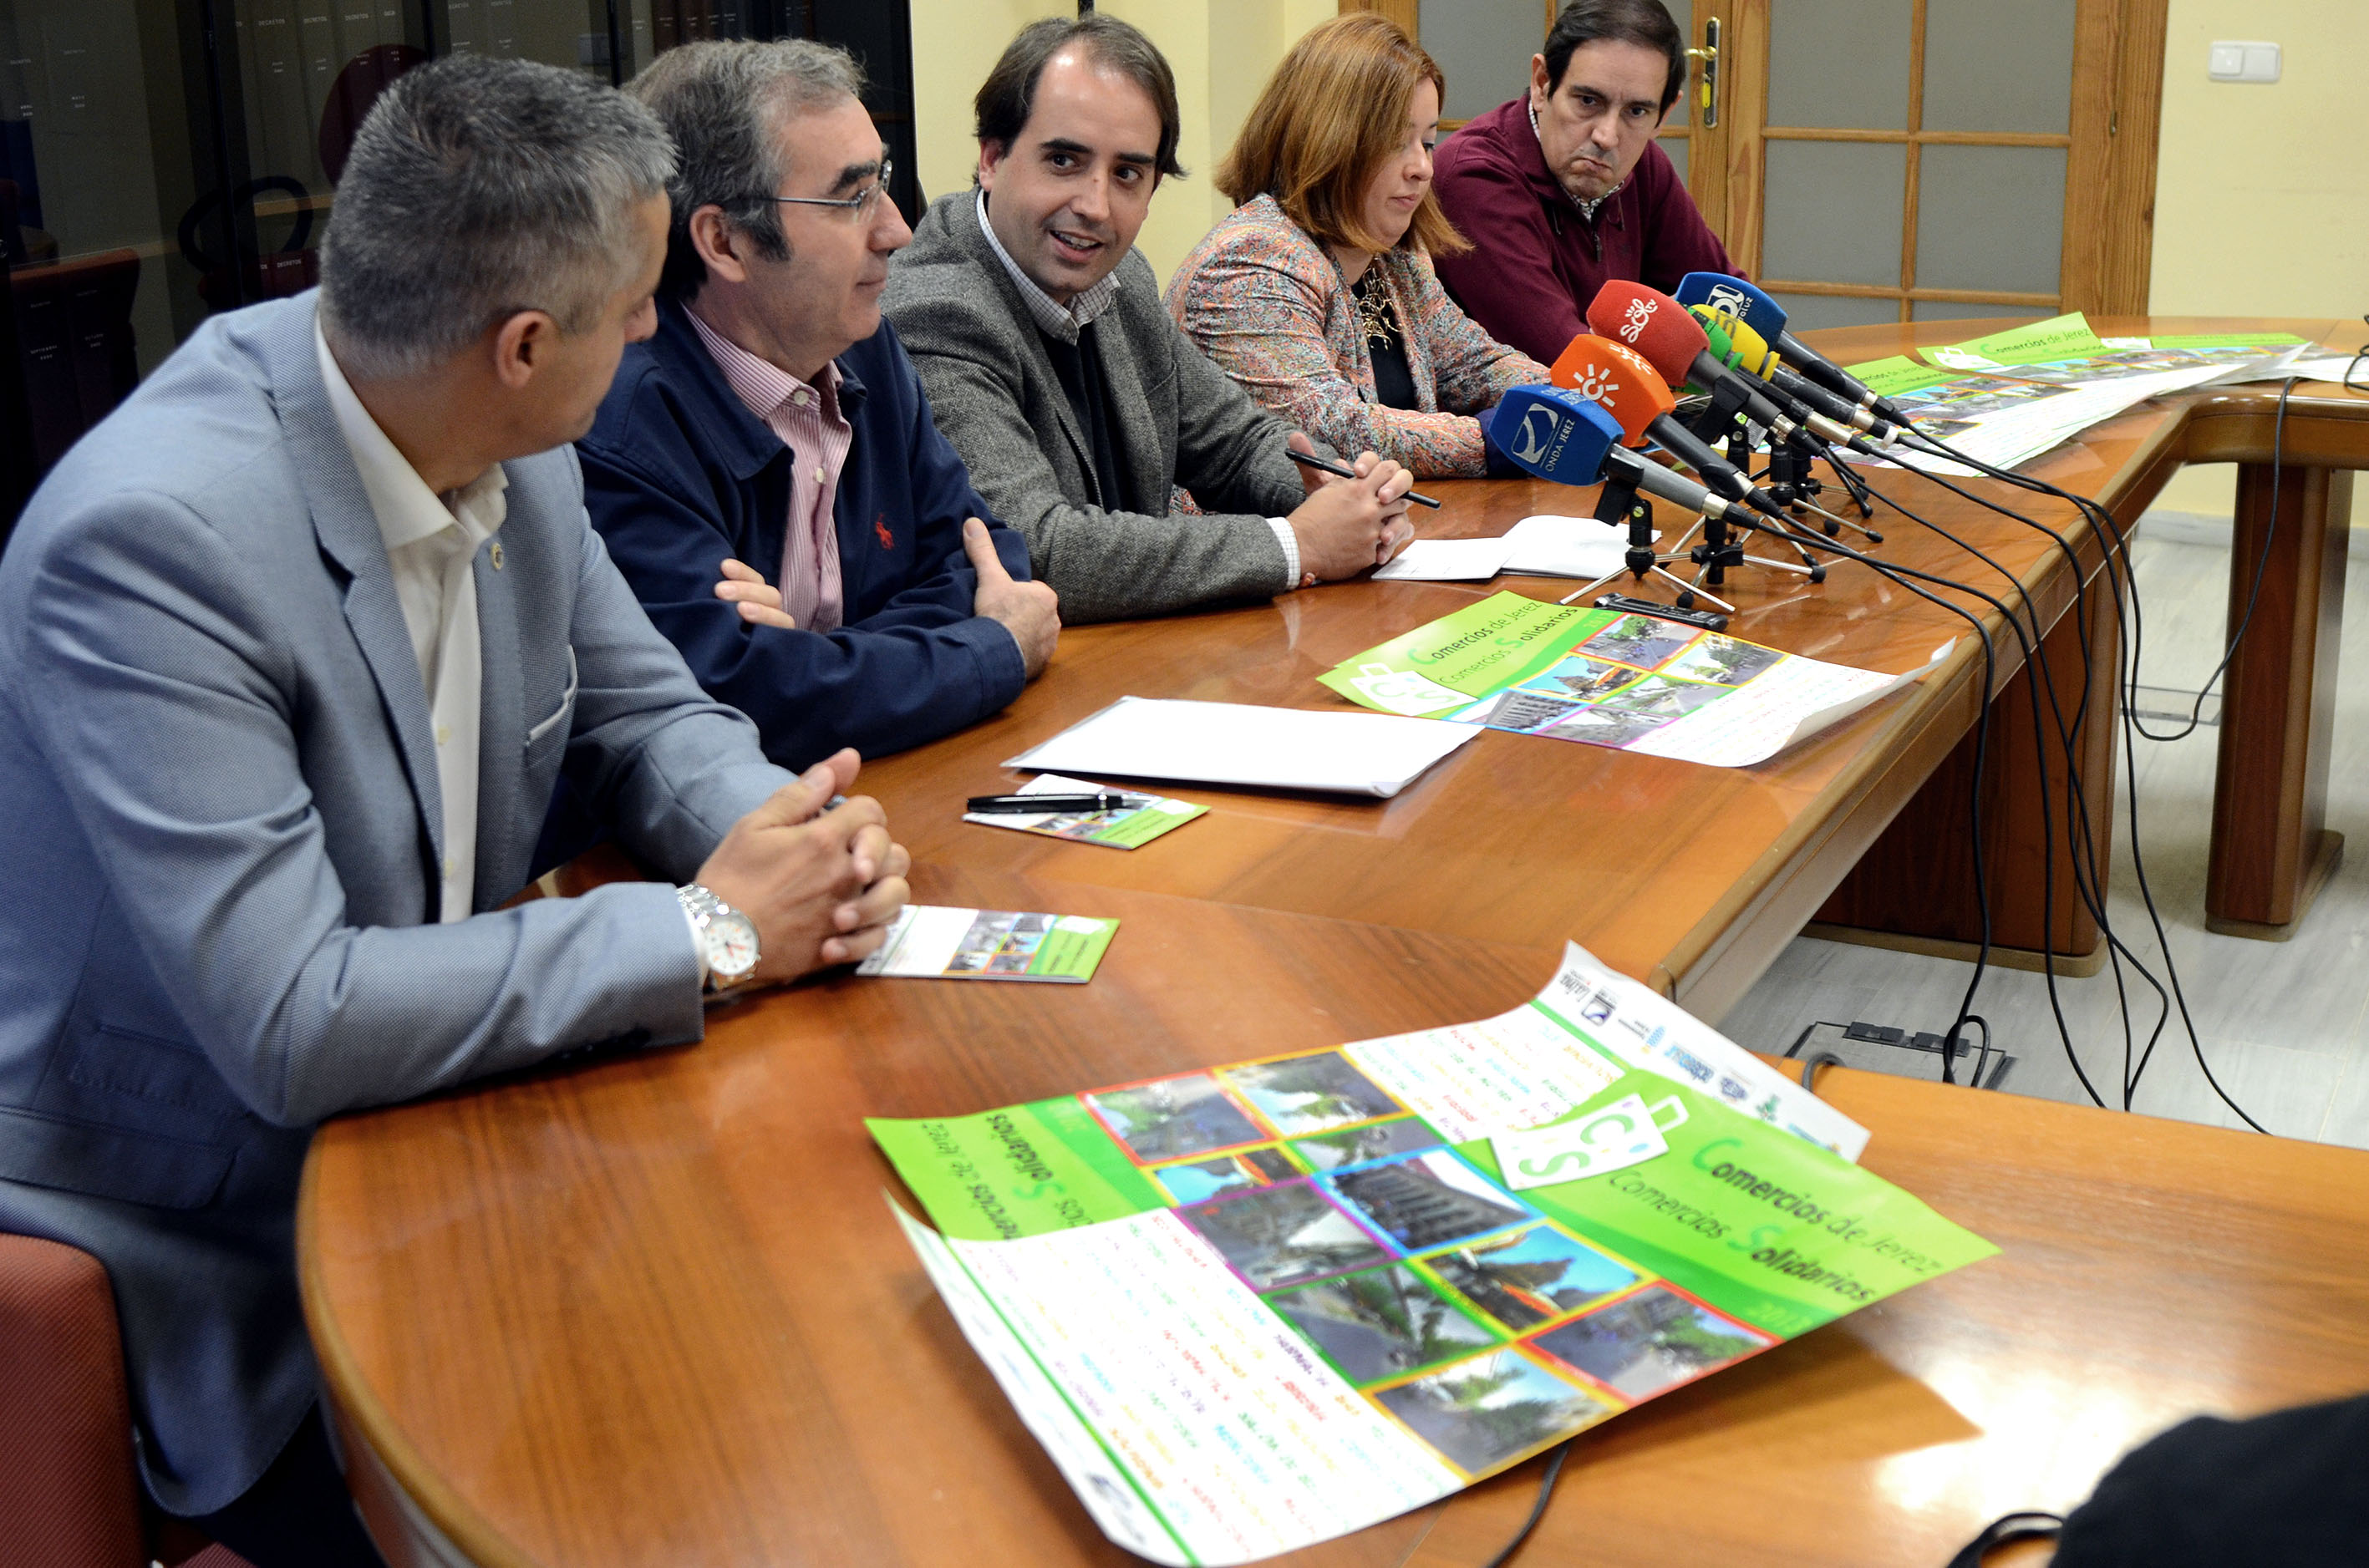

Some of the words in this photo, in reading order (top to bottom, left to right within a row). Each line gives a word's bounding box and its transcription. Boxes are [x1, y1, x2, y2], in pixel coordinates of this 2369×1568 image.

[1545, 444, 1564, 472] ONDA
[1559, 419, 1575, 443] JEREZ
[1407, 627, 1494, 667] Comercios
[1492, 618, 1507, 632] de
[1510, 601, 1543, 624] Jerez
[1438, 647, 1512, 686] Comercios
[1494, 607, 1578, 649] Solidarios
[1609, 1169, 1732, 1240] Comercios
[1727, 1224, 1877, 1303] Solidarios
[1693, 1137, 1831, 1225] Comercios
[1827, 1215, 1865, 1243] de
[1863, 1230, 1944, 1274] Jerez
